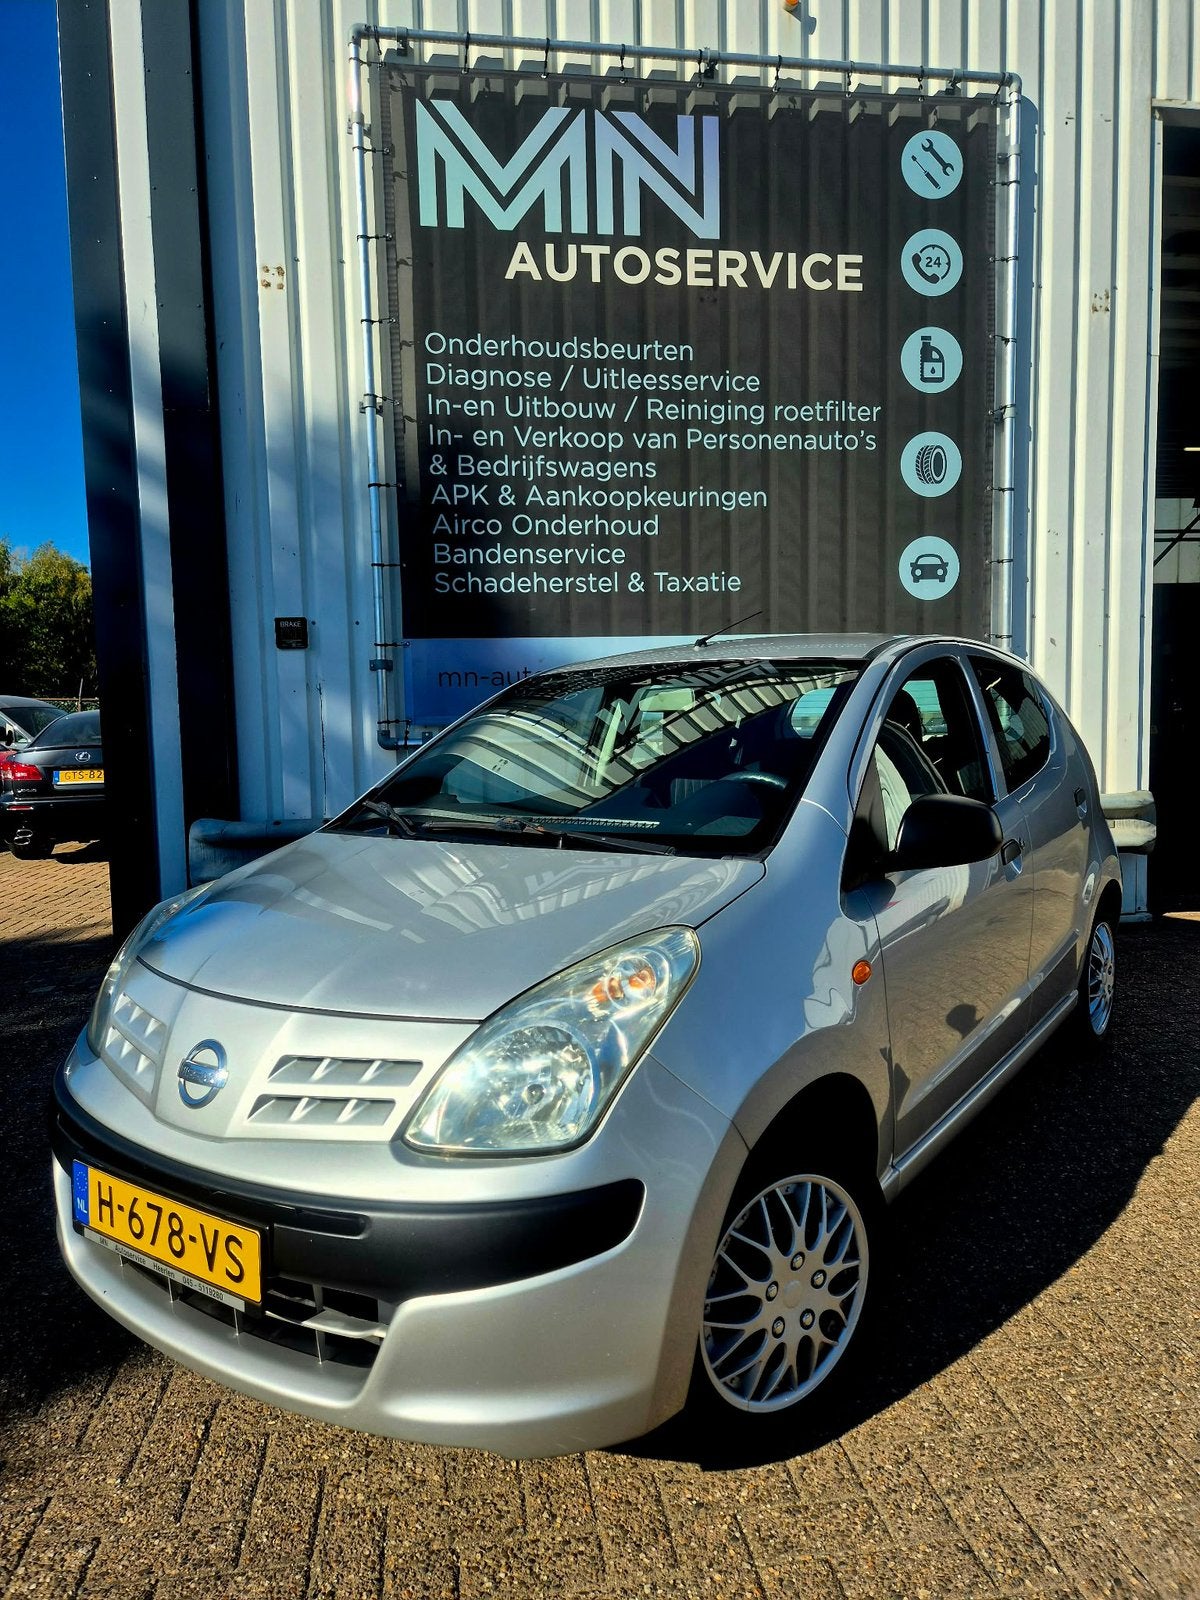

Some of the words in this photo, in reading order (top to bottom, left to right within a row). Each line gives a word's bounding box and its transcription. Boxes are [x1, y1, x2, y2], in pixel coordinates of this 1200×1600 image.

[415, 98, 721, 240] MN
[504, 241, 865, 292] AUTOSERVICE
[925, 256, 942, 268] 24
[424, 331, 694, 361] Onderhoudsbeurten
[426, 362, 552, 391] Diagnose
[559, 364, 575, 392] /
[583, 367, 761, 393] Uitleesservice
[427, 393, 495, 417] In-en
[504, 395, 617, 419] Uitbouw
[623, 395, 639, 423] /
[647, 398, 765, 425] Reiniging
[774, 400, 882, 422] roetfilter
[429, 423, 464, 446] In-
[472, 429, 504, 447] en
[513, 425, 624, 453] Verkoop
[632, 432, 677, 450] van
[686, 428, 877, 451] Personenauto’s
[429, 454, 448, 476] &
[457, 454, 657, 481] Bedrijfswagens
[431, 483, 490, 506] APK
[497, 484, 517, 507] &
[525, 485, 767, 511] Aankoopkeuringen
[432, 513, 503, 536] Airco
[511, 513, 659, 536] Onderhoud
[433, 542, 626, 565] Bandenservice
[434, 571, 619, 594] Schadeherstel
[627, 571, 646, 593] &
[653, 571, 742, 593] Taxatie
[438, 666, 541, 688] mn-aut
[77, 1197, 88, 1214] NL
[97, 1180, 245, 1284] H-678-VS
